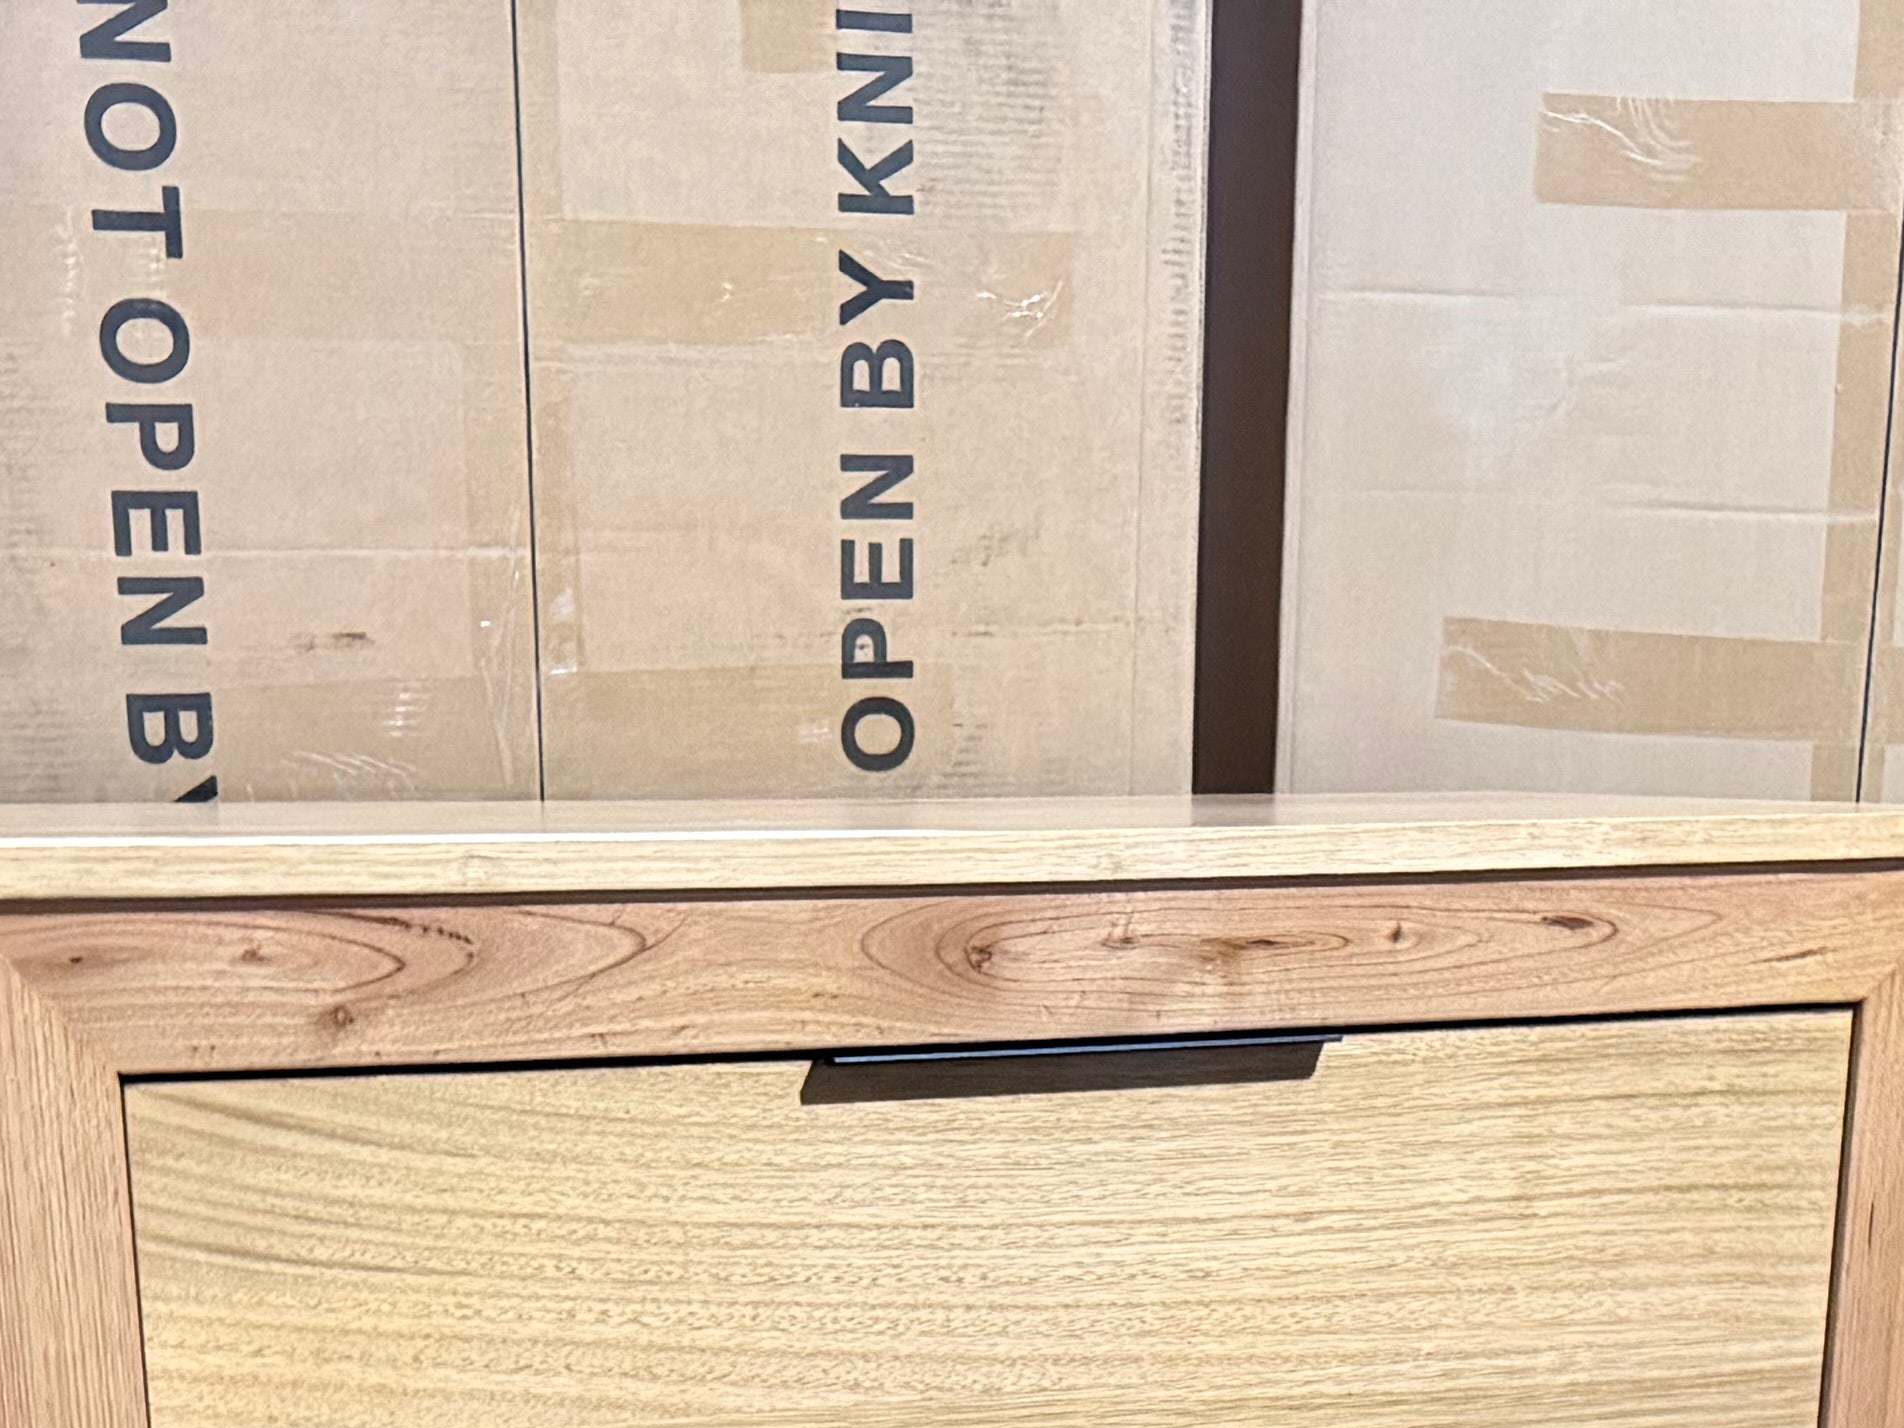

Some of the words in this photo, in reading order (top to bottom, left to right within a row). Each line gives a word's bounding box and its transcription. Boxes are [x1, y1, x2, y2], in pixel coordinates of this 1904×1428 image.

[75, 0, 185, 261] NOT
[835, 8, 915, 215] KNI
[838, 248, 915, 410] BY
[99, 297, 209, 646] OPEN
[840, 453, 915, 773] OPEN
[125, 691, 219, 802] B
